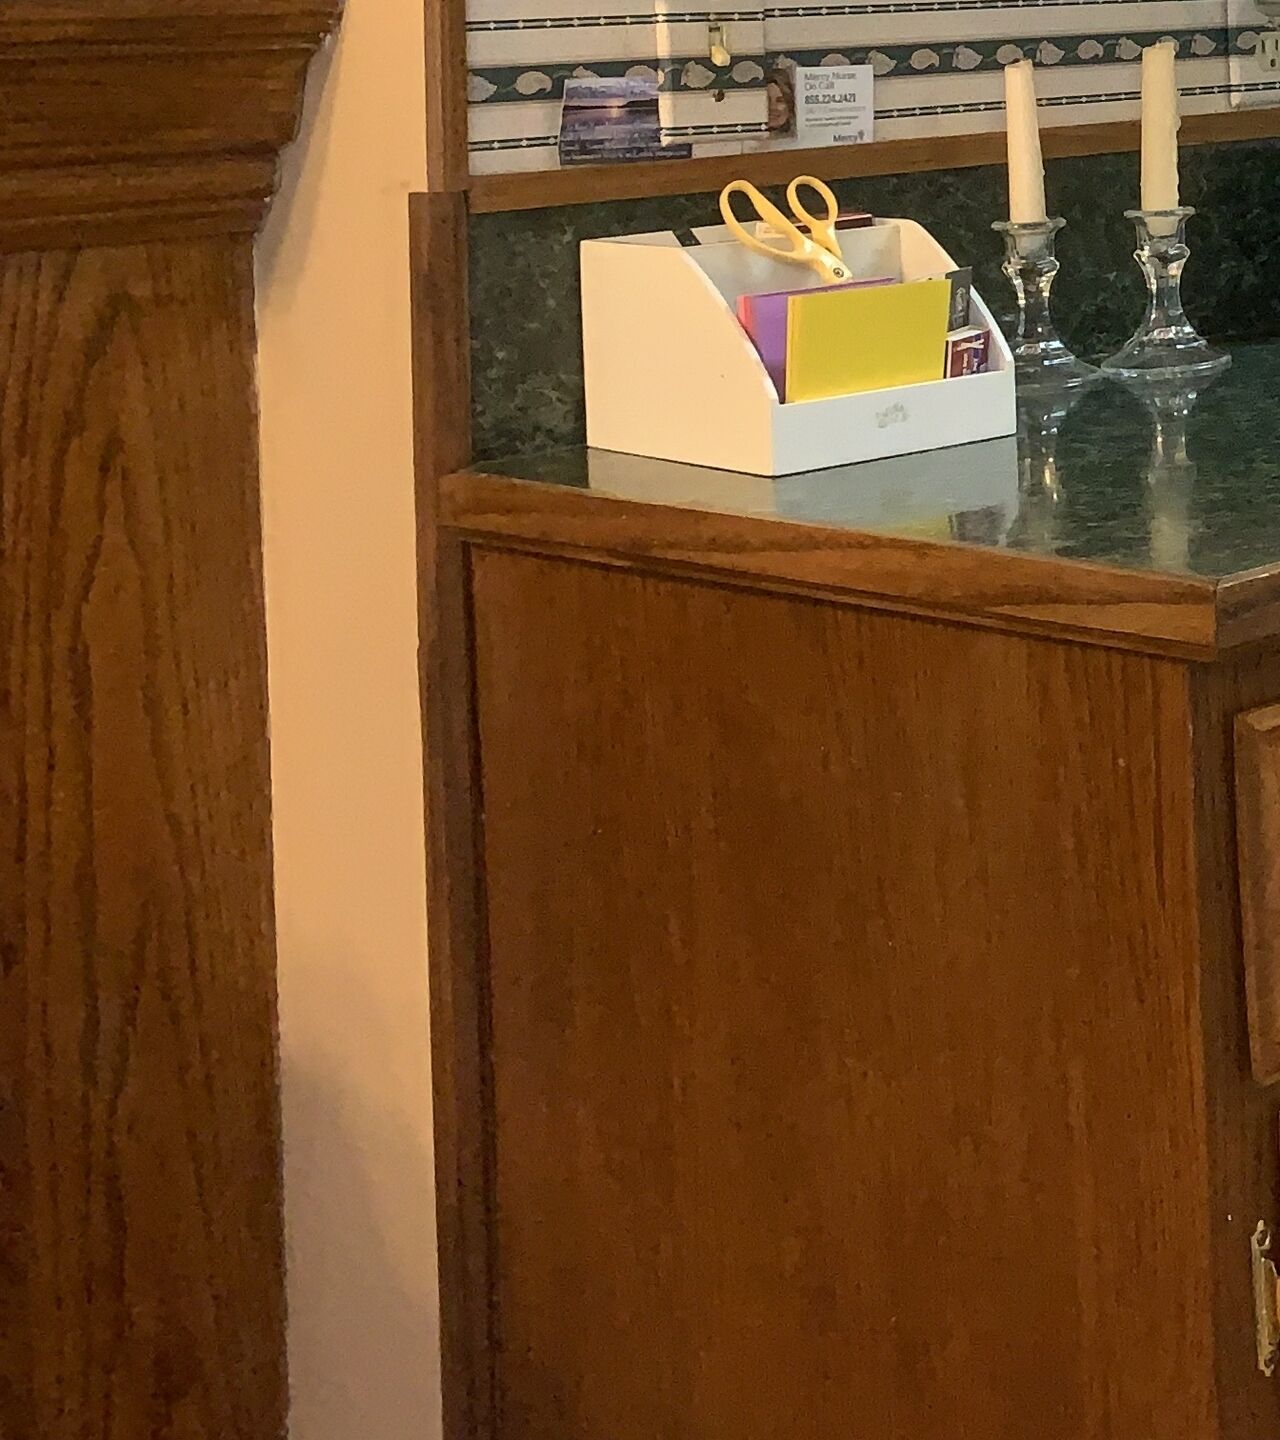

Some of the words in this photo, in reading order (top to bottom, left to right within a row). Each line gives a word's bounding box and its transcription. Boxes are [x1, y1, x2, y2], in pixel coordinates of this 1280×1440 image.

[804, 82, 817, 91] On
[818, 81, 835, 90] Call
[833, 134, 858, 144] Mercy
